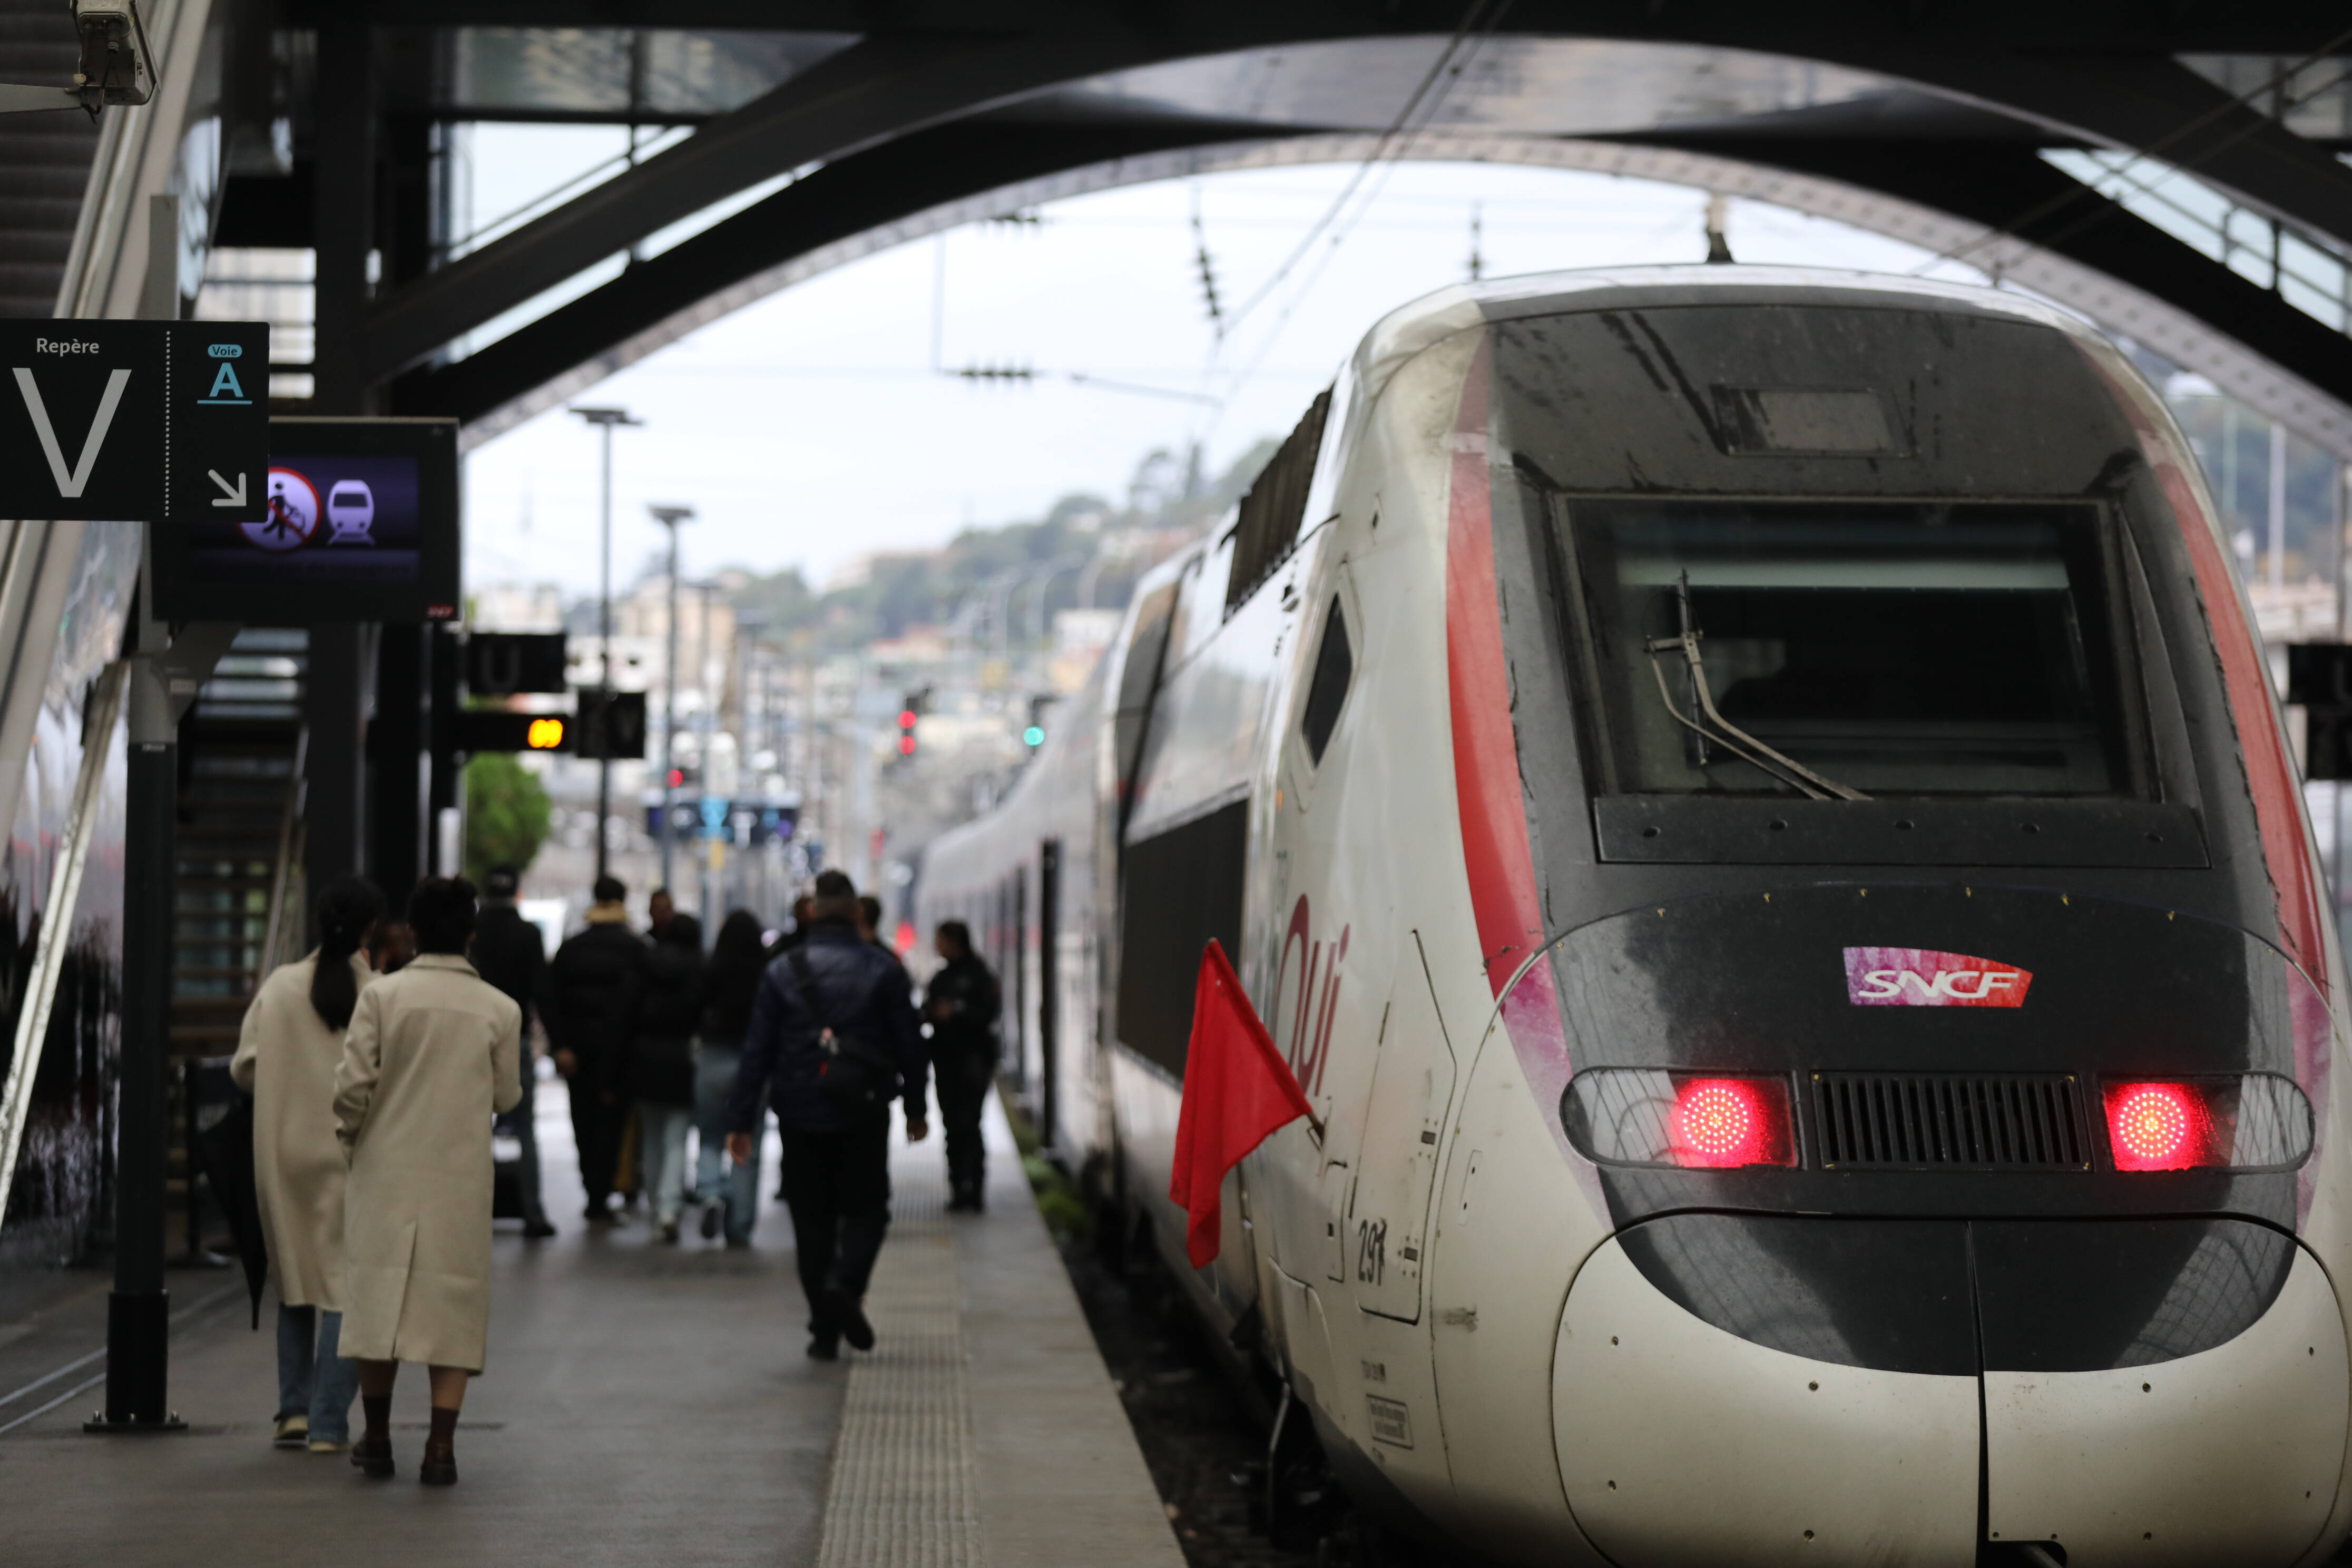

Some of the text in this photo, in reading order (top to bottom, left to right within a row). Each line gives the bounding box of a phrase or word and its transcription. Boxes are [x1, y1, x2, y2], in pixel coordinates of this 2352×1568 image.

[36, 338, 100, 356] Repère
[212, 346, 238, 357] Voie
[209, 362, 244, 397] A
[12, 367, 132, 498] V
[1857, 969, 2019, 998] SNCF
